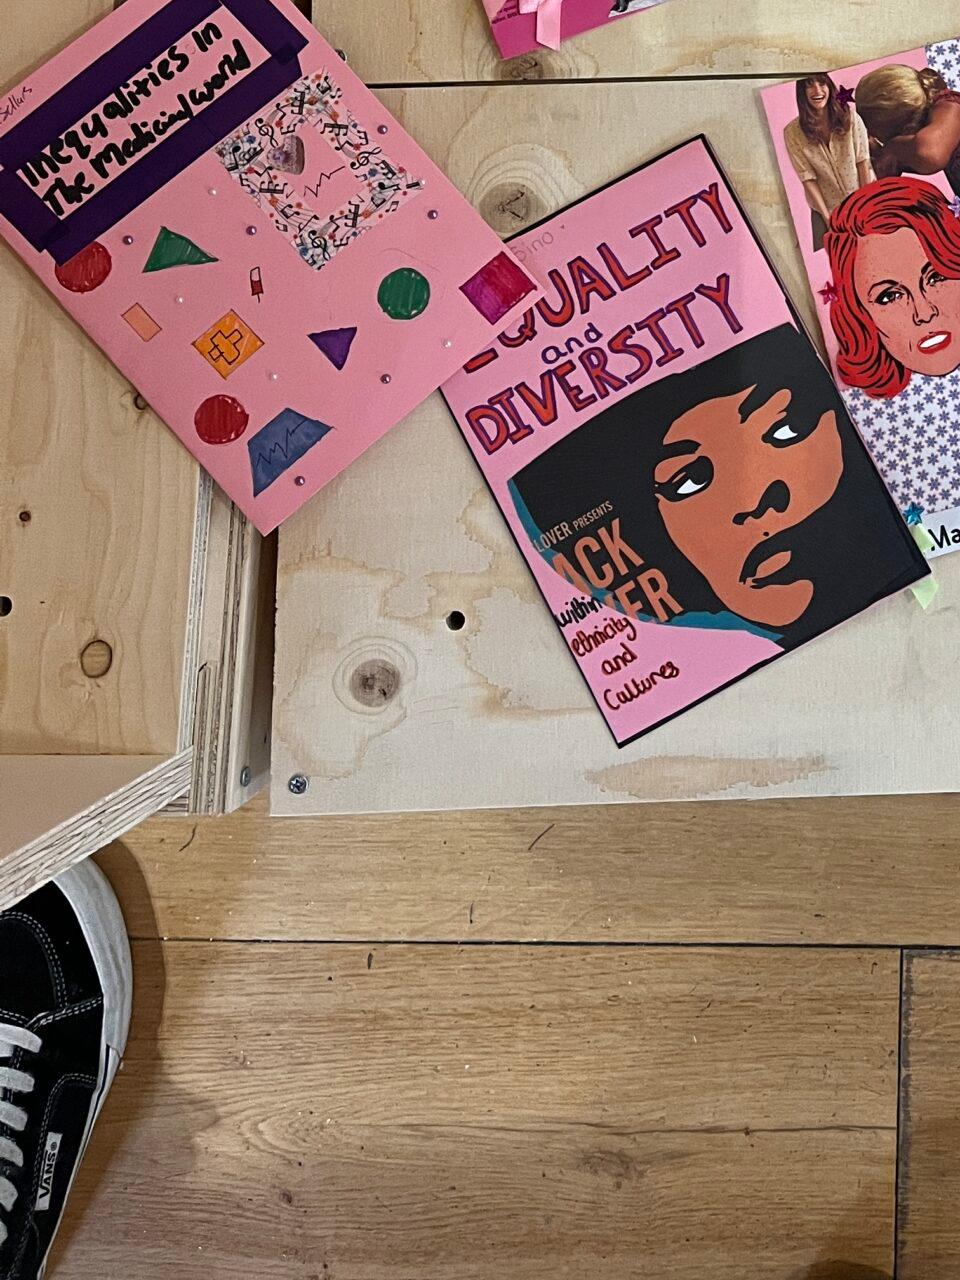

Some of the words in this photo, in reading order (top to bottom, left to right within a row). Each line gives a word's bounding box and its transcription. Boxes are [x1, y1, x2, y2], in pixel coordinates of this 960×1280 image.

[42, 171, 95, 216] The
[188, 38, 251, 106] world
[463, 182, 734, 374] QUALITY
[465, 272, 744, 456] DIVERSITY
[541, 322, 604, 365] and
[533, 523, 573, 552] LOVER
[573, 500, 614, 532] PRESENTS
[554, 595, 603, 628] within
[570, 616, 638, 657] ethnicity
[601, 642, 638, 676] and
[38, 1151, 57, 1199] VANS
